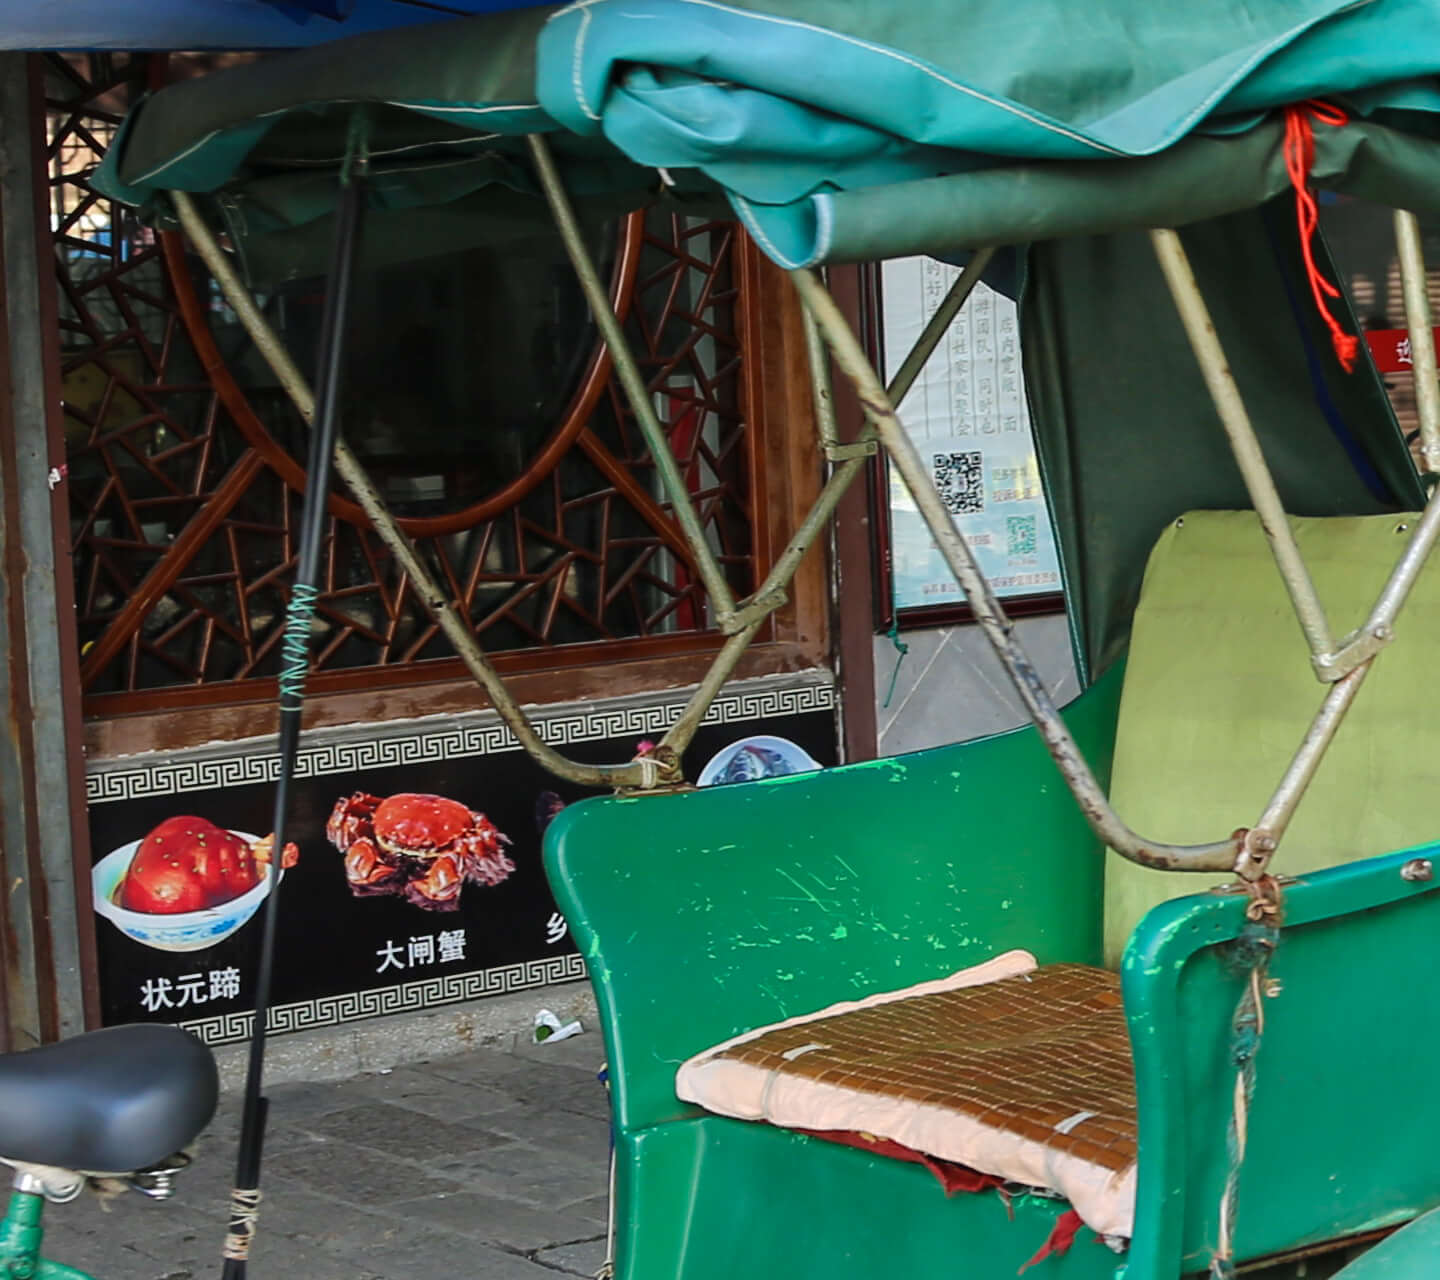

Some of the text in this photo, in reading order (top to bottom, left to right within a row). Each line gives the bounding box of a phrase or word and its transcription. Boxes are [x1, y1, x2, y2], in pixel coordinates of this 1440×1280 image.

[376, 928, 468, 974] 大闸蟹
[140, 966, 241, 1013] 状元蹄
